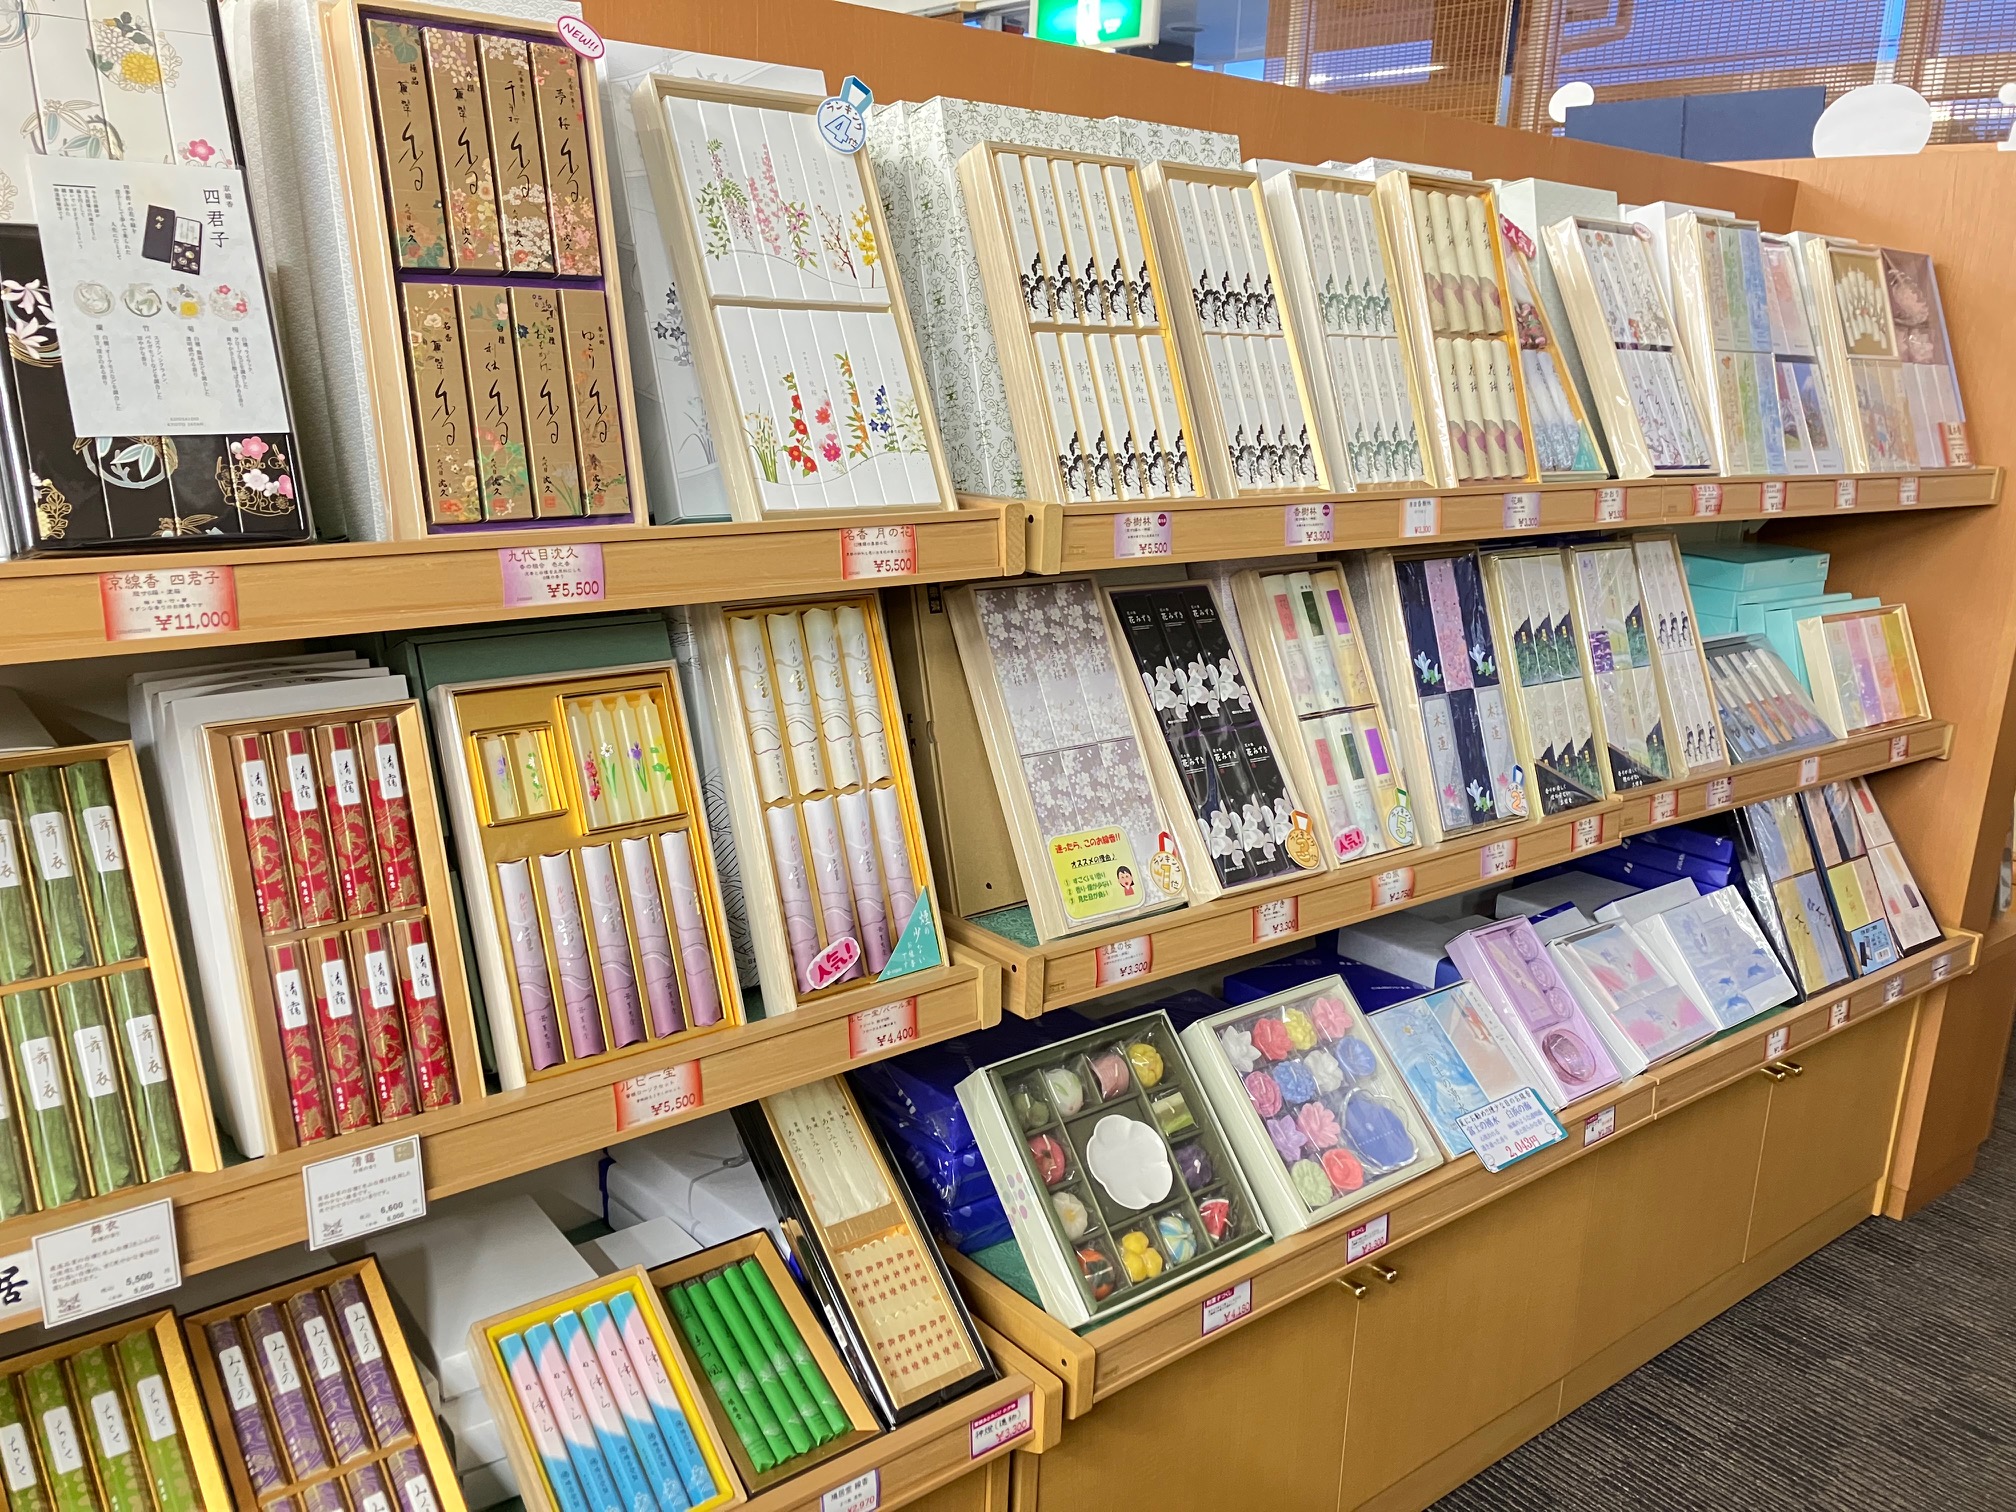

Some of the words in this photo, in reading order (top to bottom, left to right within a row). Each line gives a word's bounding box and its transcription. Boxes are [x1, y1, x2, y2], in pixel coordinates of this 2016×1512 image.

[562, 22, 599, 53] NEW!!
[827, 101, 862, 130] ランキング
[203, 188, 229, 248] 四君子
[1124, 516, 1152, 527] 香樹林
[844, 528, 868, 541] 名香
[876, 525, 913, 540] 月の花
[1306, 530, 1331, 542] ¥3,300
[508, 547, 579, 563] 九代目沈久
[1139, 542, 1168, 554] ¥5,500
[874, 558, 912, 573] ¥5,500
[107, 573, 160, 591] 京線香
[170, 570, 219, 585] 四君子
[547, 580, 600, 598] ¥5,500
[154, 610, 231, 631] ¥11,000
[1128, 615, 1152, 624] 花みずき
[1161, 611, 1184, 620] 花みずき
[1192, 608, 1215, 618] 花みずき
[1488, 705, 1502, 740] 木蓮
[1434, 712, 1449, 751] 木蓮
[1214, 750, 1237, 762] 花みずき
[1246, 745, 1268, 757] 花みずき
[1181, 756, 1205, 768] 花みずき
[1055, 833, 1120, 854] 迷ったら、このお線香!!
[1340, 831, 1362, 853] 人気!
[1072, 872, 1106, 884] すごくいい香り
[818, 942, 854, 984] 人気!
[1120, 961, 1148, 977] ¥3,300
[877, 1027, 914, 1046] ¥4,400
[620, 1066, 676, 1093] ルビー宝
[651, 1093, 696, 1116] ¥5,500
[1505, 1134, 1541, 1158] 2,043円
[380, 1201, 404, 1214] 6,600
[90, 1220, 120, 1236] 舞衣
[126, 1271, 153, 1286] 5,500
[1224, 1302, 1250, 1322] ¥4,180
[996, 1419, 1027, 1442] ¥3,300
[854, 1477, 868, 1490] 線香
